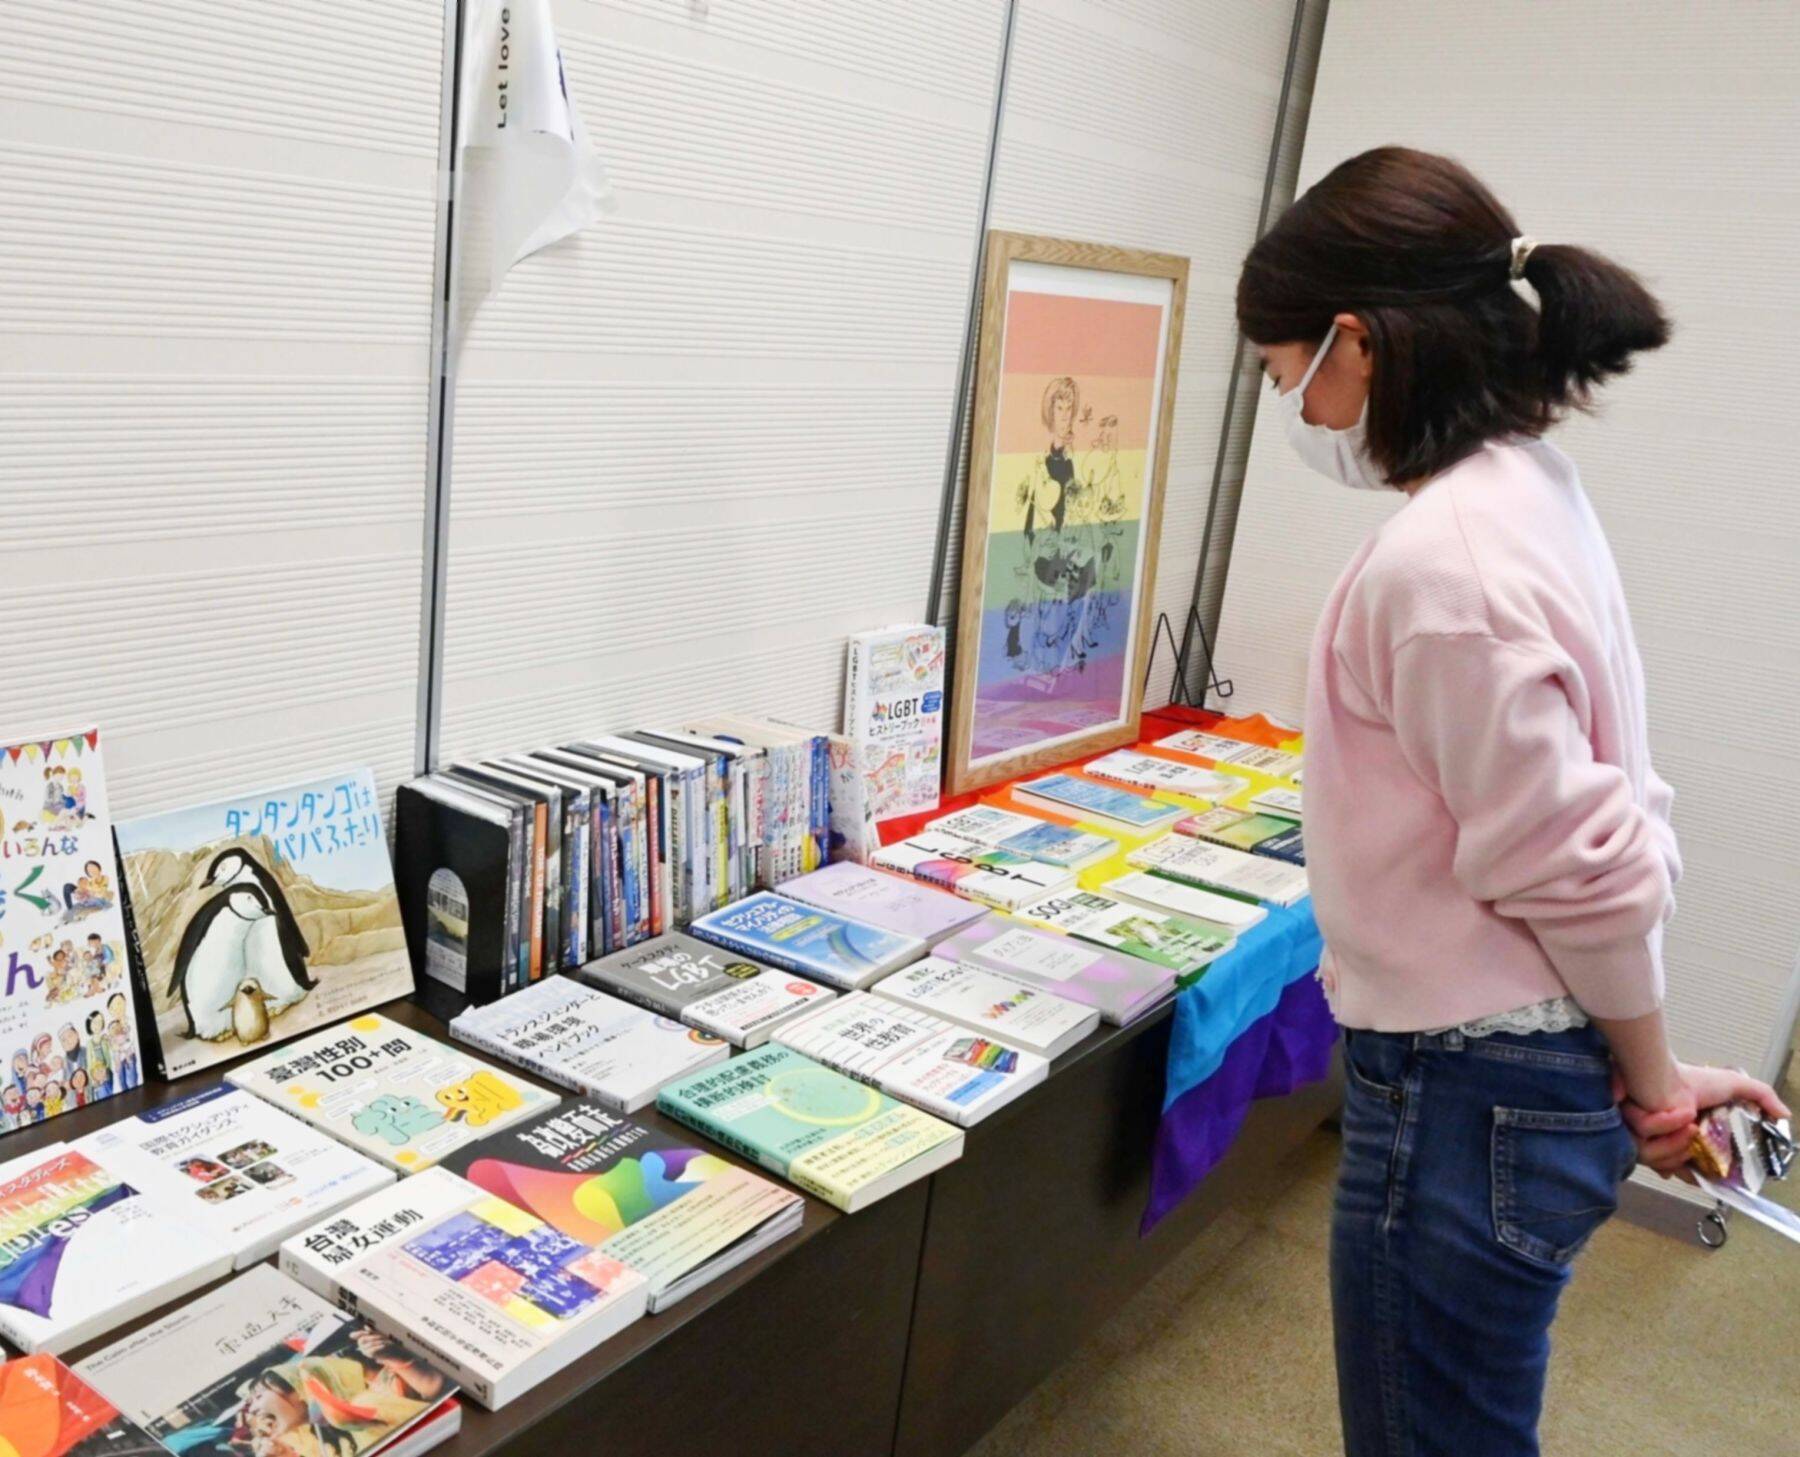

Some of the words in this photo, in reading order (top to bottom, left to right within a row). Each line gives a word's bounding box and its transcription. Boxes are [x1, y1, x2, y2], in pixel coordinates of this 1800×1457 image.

[498, 8, 512, 70] love
[497, 81, 508, 129] Let
[888, 698, 919, 720] LGBT
[226, 781, 371, 839] タンタンタンゴは
[3, 836, 78, 858] いろんな
[273, 813, 379, 864] パパふたり
[650, 955, 727, 992] LGBT
[496, 993, 602, 1041] トランスジェンダーと
[839, 1018, 886, 1042] 世界の
[863, 1022, 917, 1050] 性教育
[264, 1036, 368, 1085] 臺灣性別
[539, 1023, 600, 1058] ハンドブック
[302, 1217, 361, 1254] 台灣
[322, 1208, 424, 1266] 婦女運動
